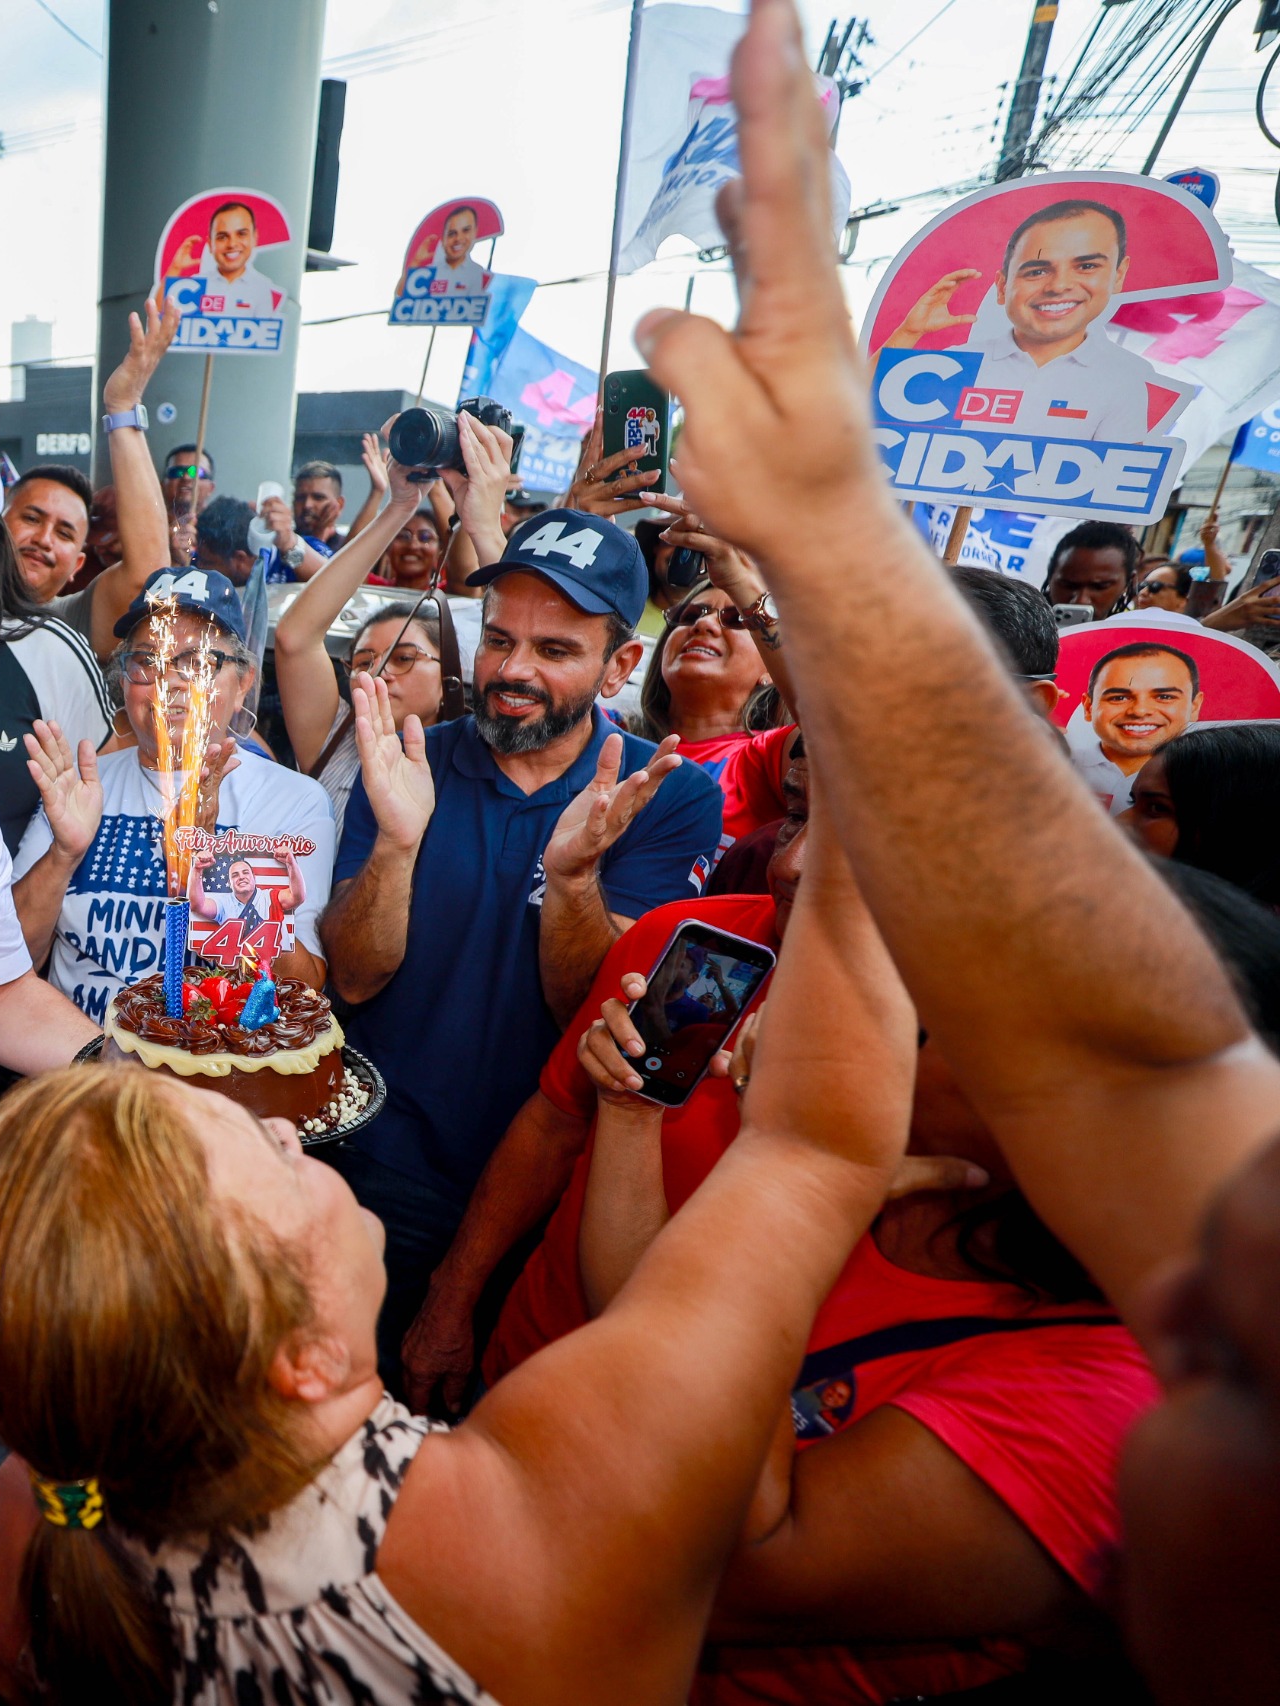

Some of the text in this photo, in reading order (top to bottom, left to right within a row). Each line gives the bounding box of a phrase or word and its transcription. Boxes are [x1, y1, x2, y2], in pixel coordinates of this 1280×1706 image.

[167, 279, 223, 314] C DE
[406, 268, 446, 297] C DE
[395, 298, 484, 320] CIDADE
[172, 317, 280, 347] IDADE
[879, 353, 1016, 422] C DE
[628, 408, 646, 418] 44
[519, 522, 604, 569] 44
[144, 571, 209, 602] 44
[202, 919, 280, 966] 44
